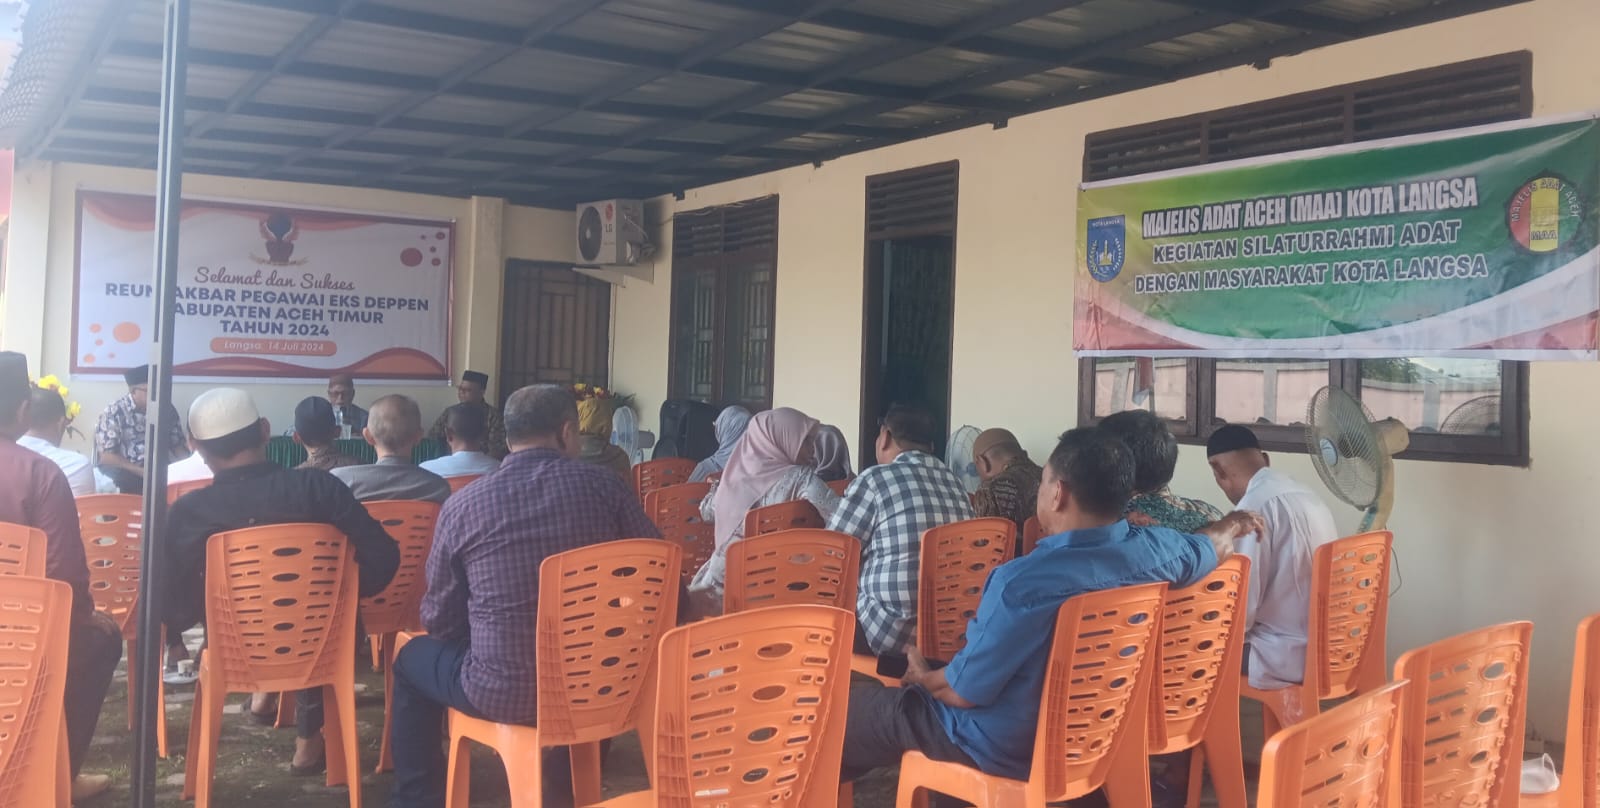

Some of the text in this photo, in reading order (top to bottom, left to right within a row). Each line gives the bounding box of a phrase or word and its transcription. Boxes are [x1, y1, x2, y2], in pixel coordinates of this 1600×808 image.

[1143, 177, 1478, 238] MAJELIS ADAT ACEH (MAA) KOTA LANGSA
[1153, 219, 1461, 264] KEGIATAN SILATURRAHMI ADAT
[195, 266, 355, 291] Selamat dan Sukses
[1135, 254, 1488, 294] DENGAN MASYARAKAT KOTA LANGSA
[175, 286, 236, 302] AKBAR
[241, 290, 325, 306] PEGAWAI
[329, 295, 360, 308] EKS
[364, 297, 429, 311] DEPPEN
[174, 303, 384, 324] ABUPATEN ACEH TIMUR
[220, 320, 329, 336] TAHUN 2024
[268, 341, 279, 351] 14
[282, 342, 298, 351] Juli
[300, 342, 324, 352] 2024
